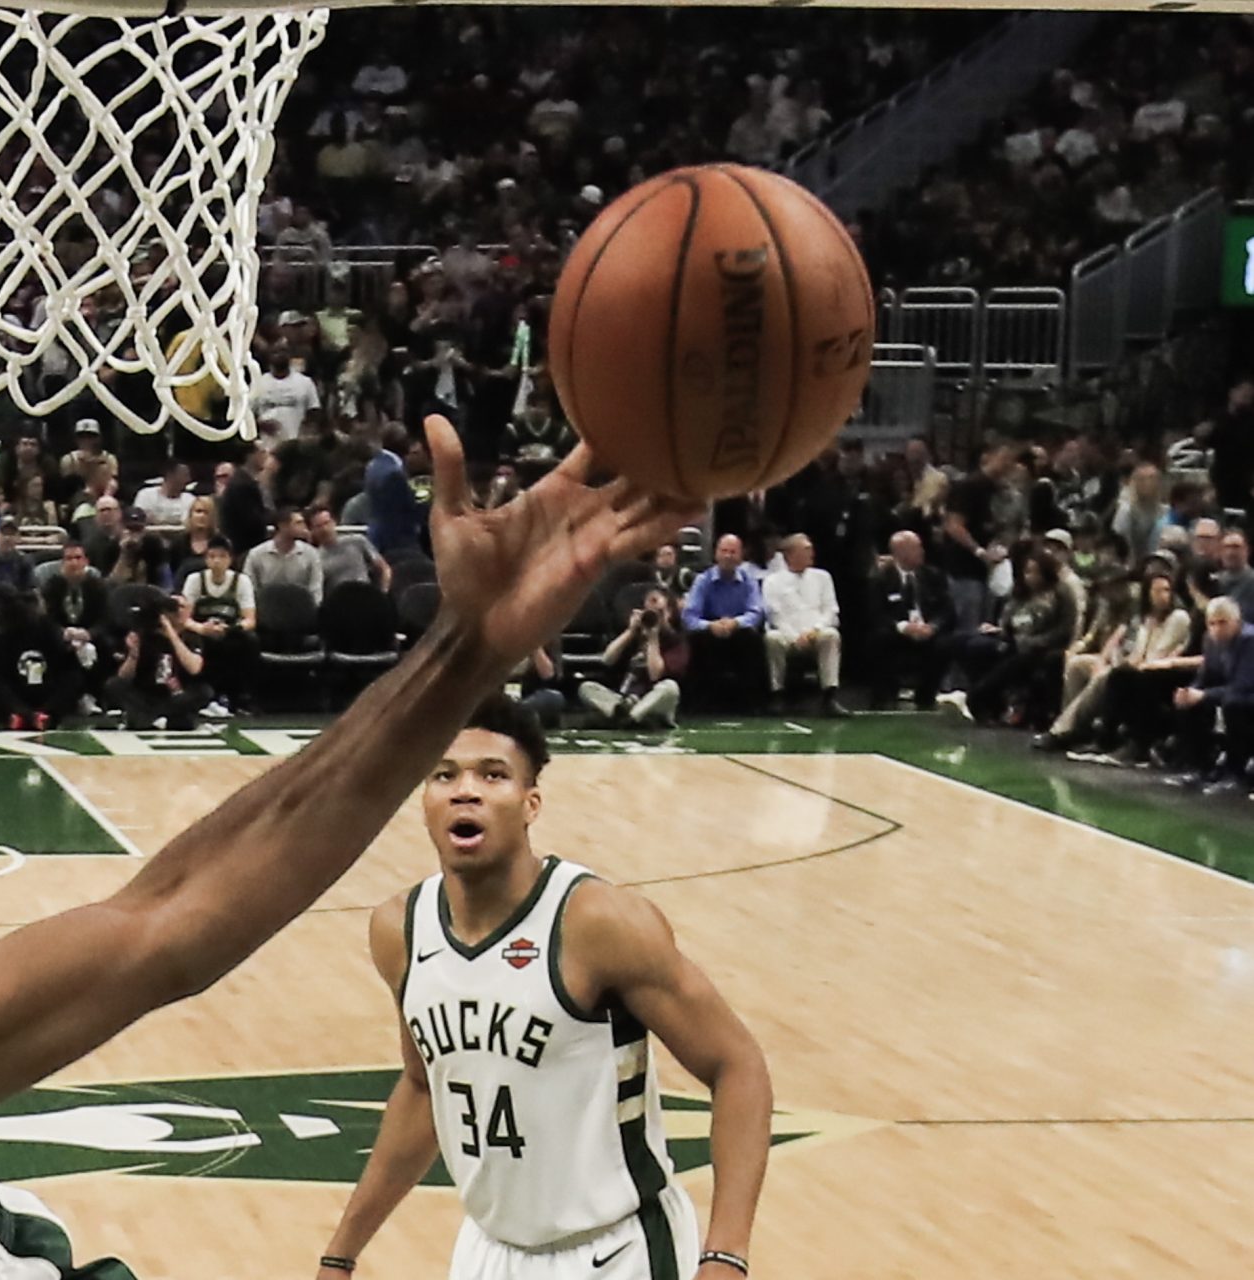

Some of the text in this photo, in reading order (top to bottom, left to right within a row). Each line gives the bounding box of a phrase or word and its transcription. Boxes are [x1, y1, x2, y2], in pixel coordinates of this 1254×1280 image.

[709, 243, 768, 471] SPALDING
[409, 1000, 554, 1068] BUCKS
[447, 1081, 526, 1169] 34
